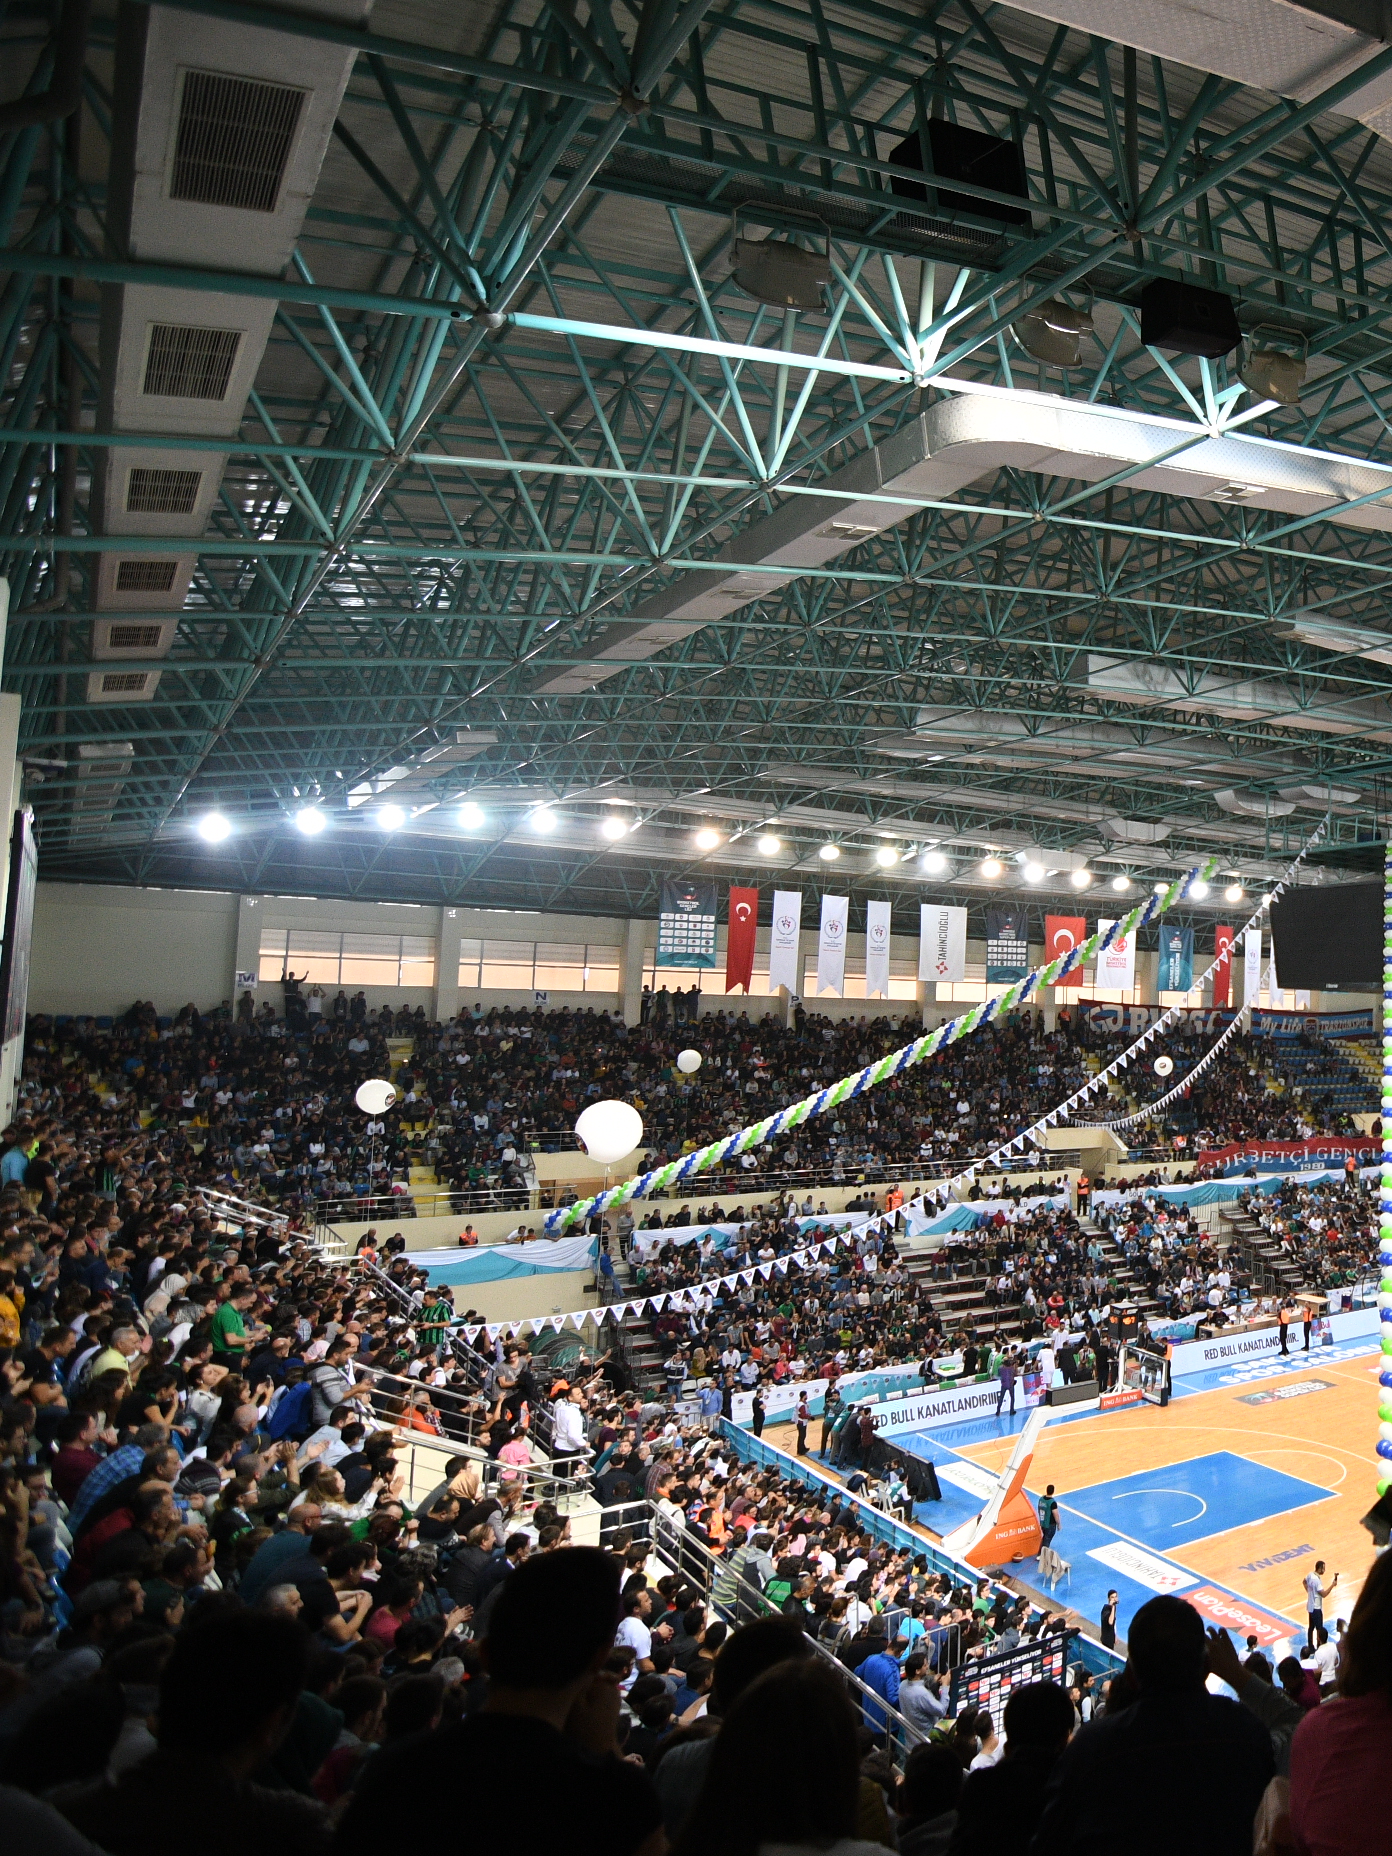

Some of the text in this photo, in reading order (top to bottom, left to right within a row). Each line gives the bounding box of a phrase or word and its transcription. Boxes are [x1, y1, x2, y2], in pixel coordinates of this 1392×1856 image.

[937, 911, 949, 961] TAHİNCİOĞLU
[535, 991, 548, 1001] N
[791, 995, 800, 1003] P
[1260, 1016, 1278, 1036] My
[1204, 1348, 1219, 1360] RED
[1219, 1342, 1237, 1357] BULL
[1219, 1365, 1292, 1384] SPOR
[1103, 1394, 1138, 1407] ING BANK
[891, 1408, 915, 1426] BULL
[995, 1524, 1036, 1540] ING BANK
[1193, 1591, 1283, 1641] LeasePlan
